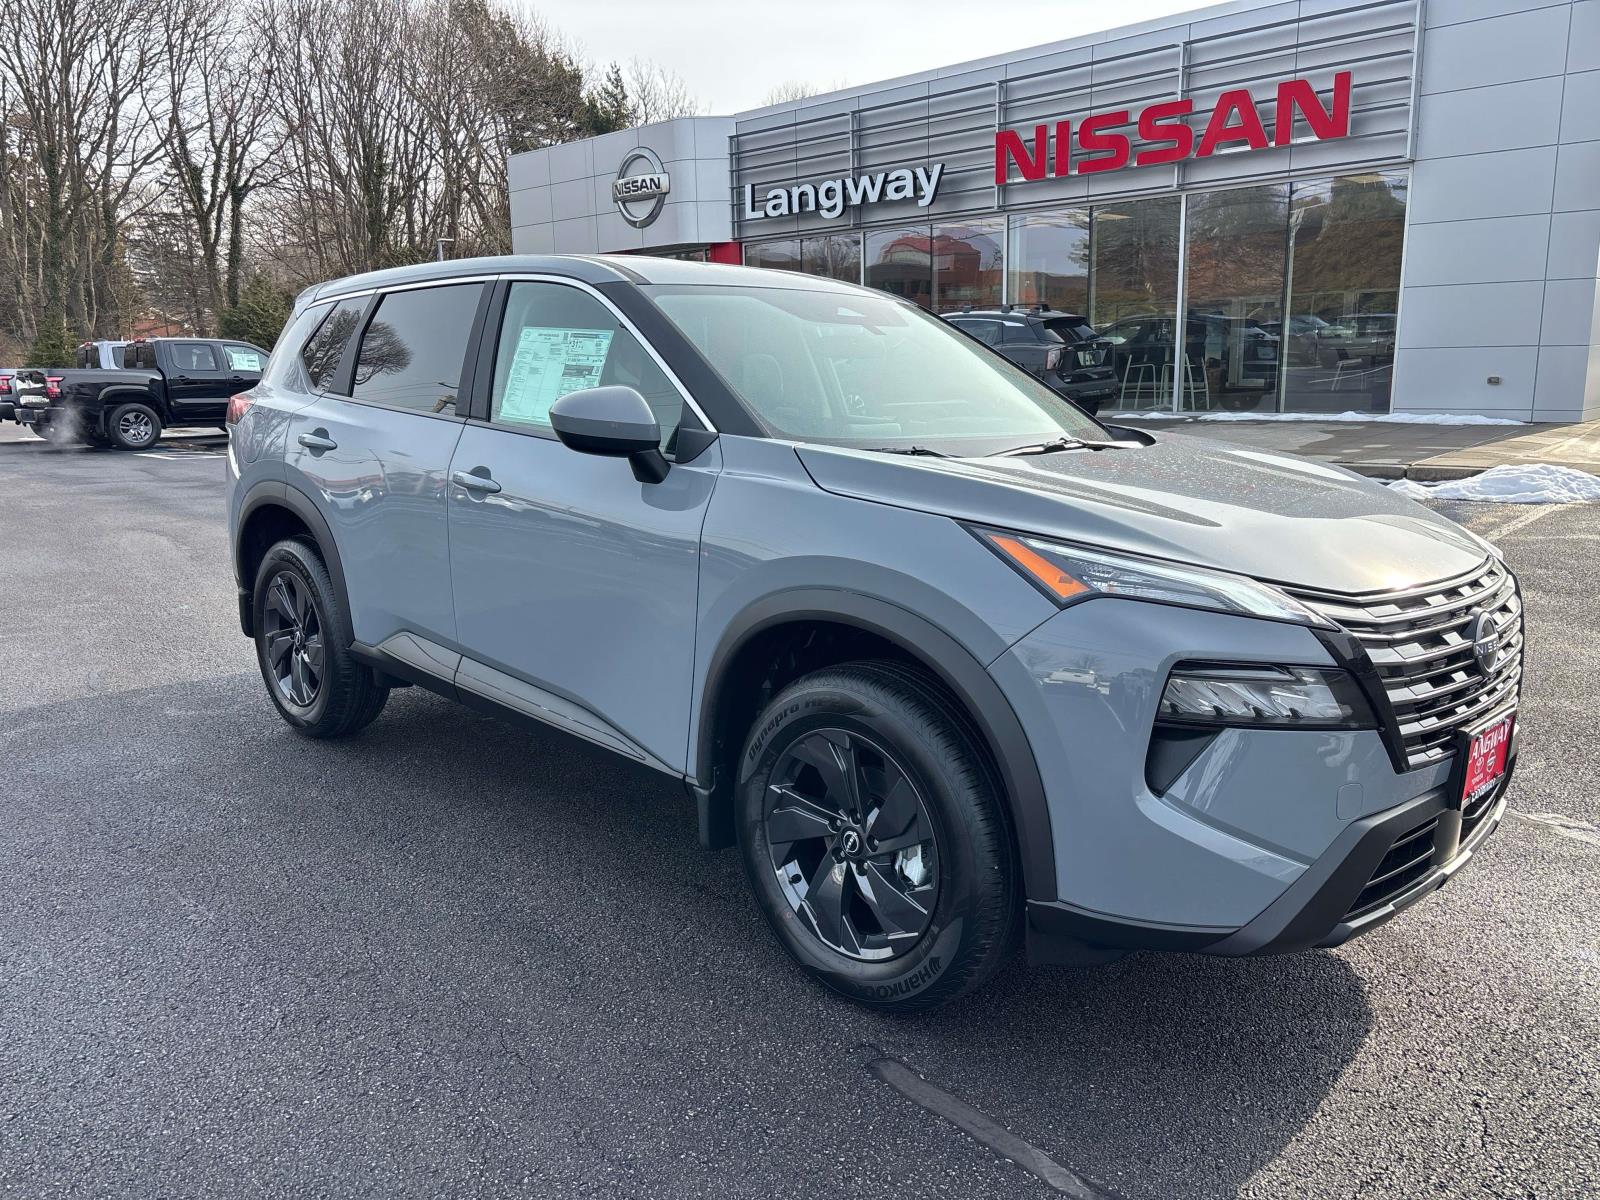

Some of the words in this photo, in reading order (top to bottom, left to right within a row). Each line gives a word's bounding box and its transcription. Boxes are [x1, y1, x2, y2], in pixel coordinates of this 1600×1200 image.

[995, 71, 1352, 186] NISSAN
[613, 176, 661, 199] NISSAN
[745, 163, 945, 221] Langway
[1475, 640, 1499, 655] NISS
